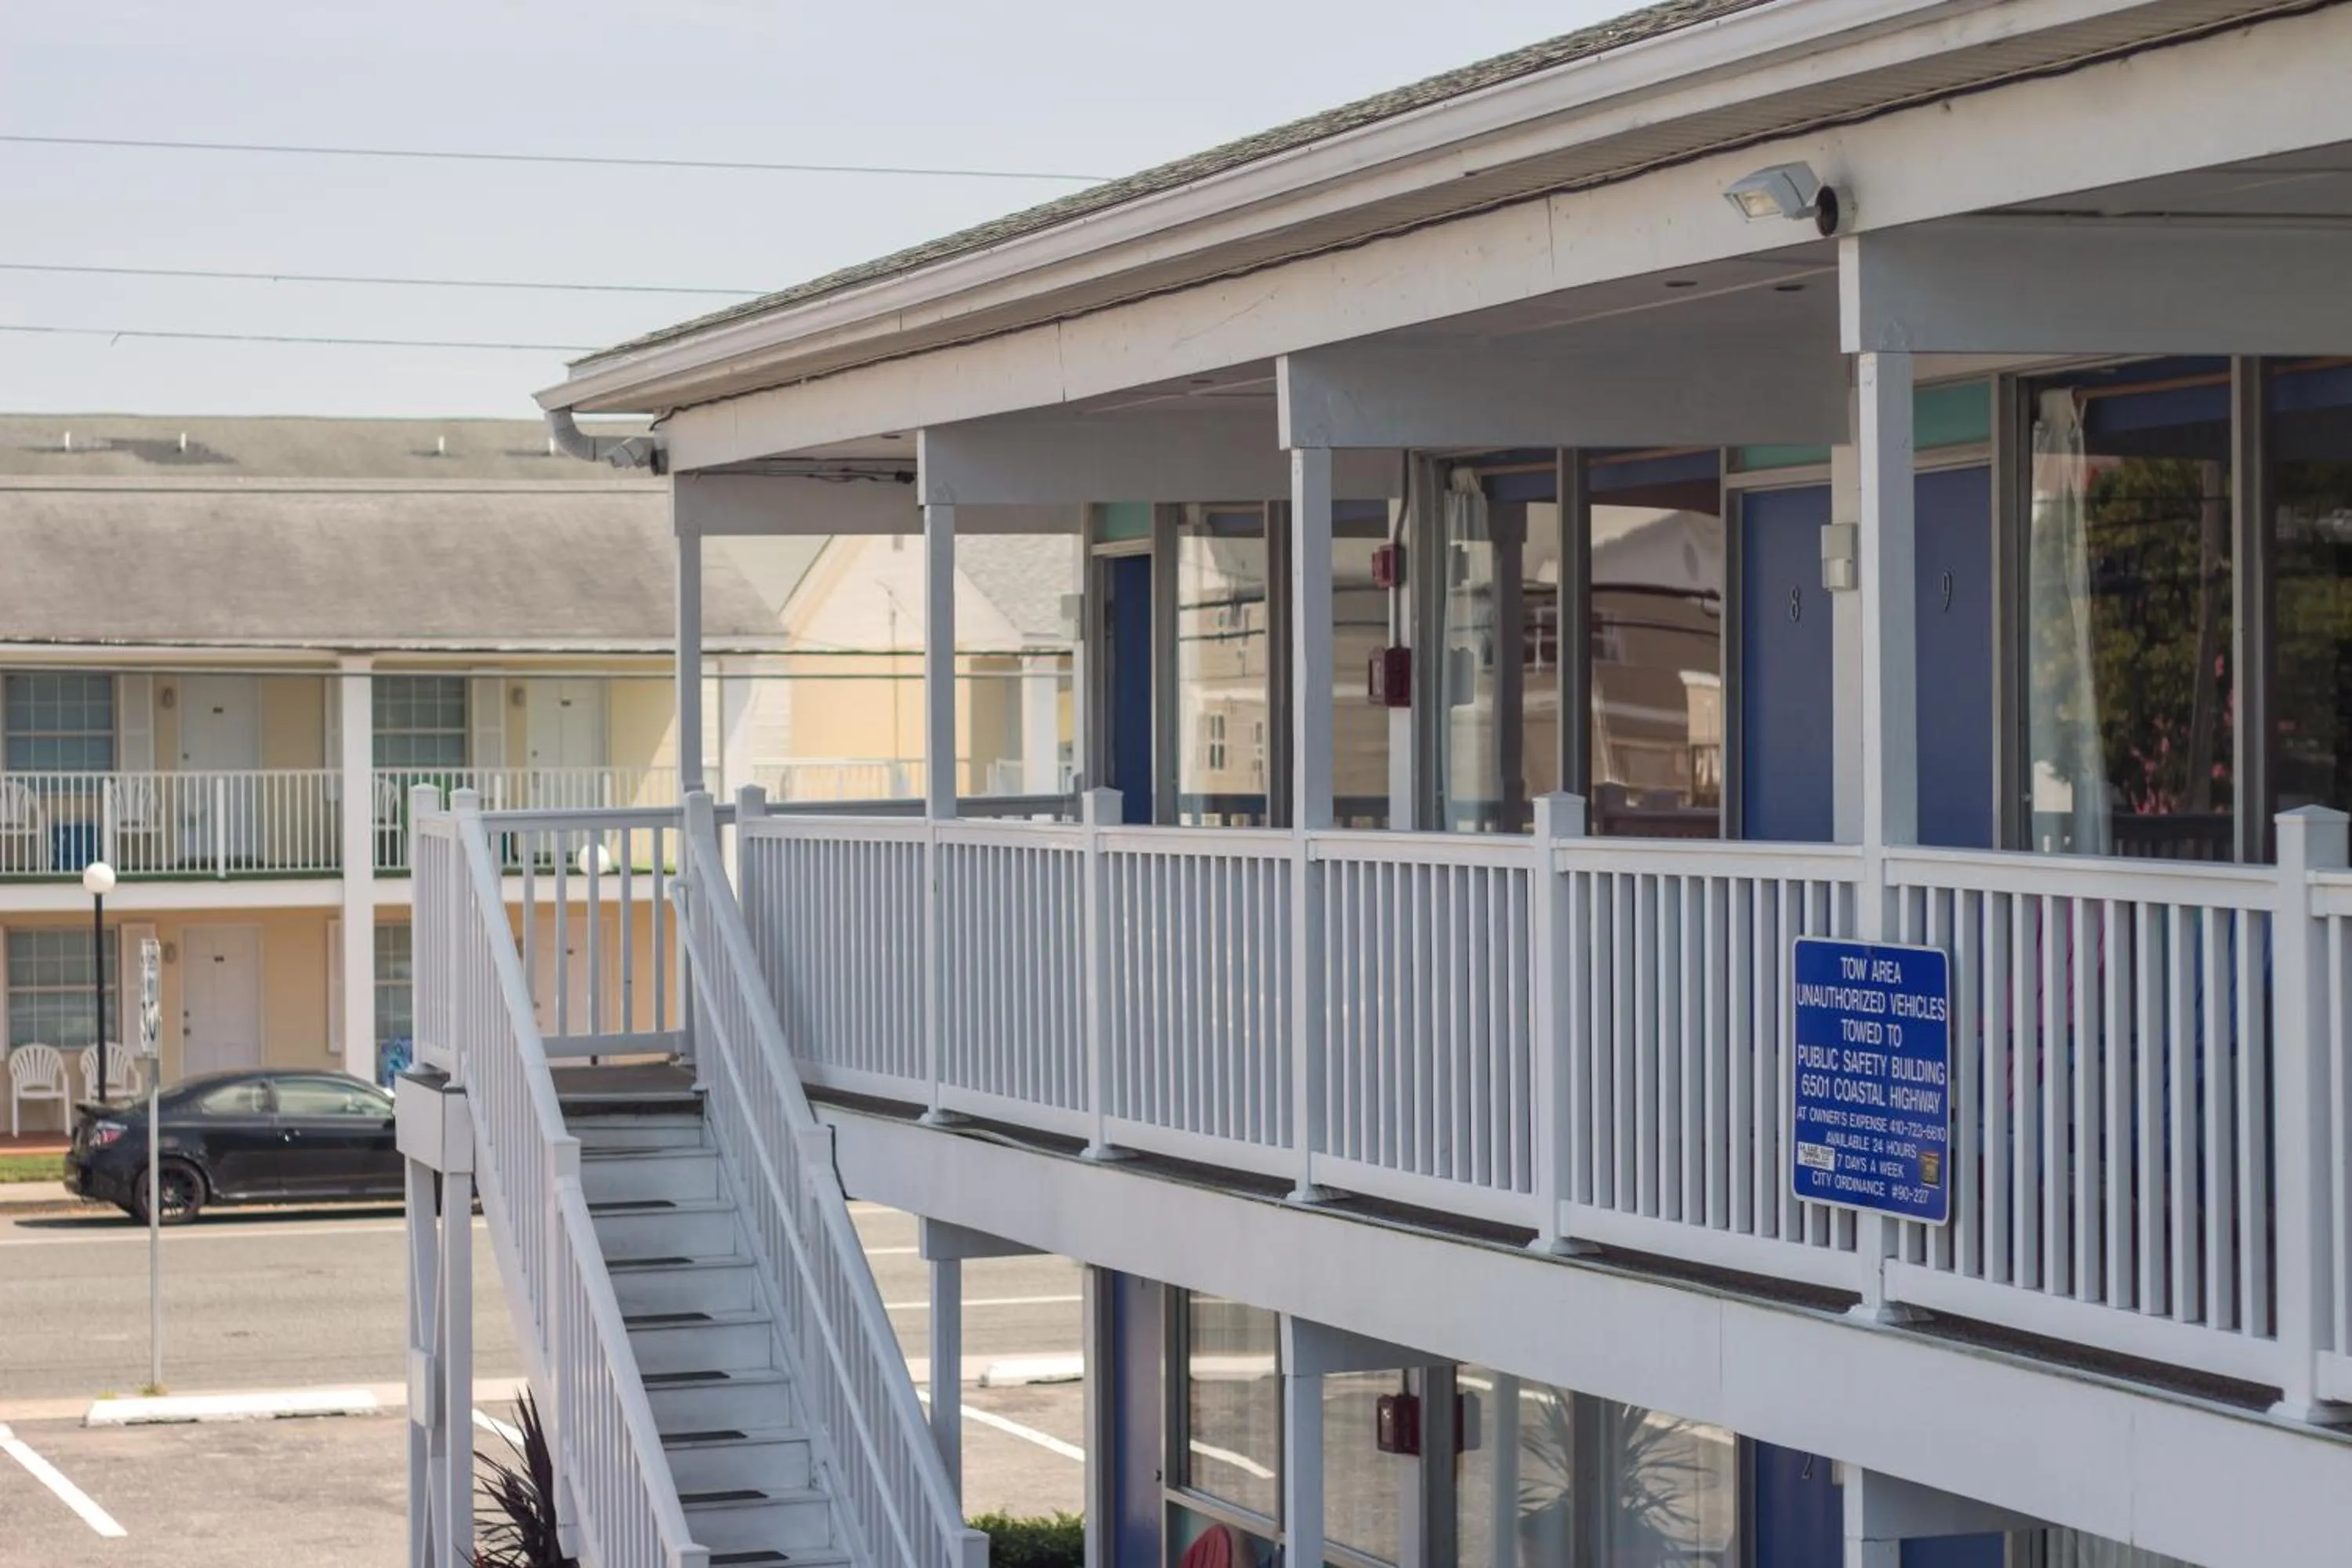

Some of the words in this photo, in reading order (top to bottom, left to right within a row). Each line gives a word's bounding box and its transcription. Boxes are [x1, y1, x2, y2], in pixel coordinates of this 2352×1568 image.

[1840, 956, 1867, 980] TOW
[1871, 960, 1902, 985] AREA
[1797, 984, 1886, 1014] UNAUTHORIZED
[1890, 993, 1946, 1022] VEHICLES
[1841, 1018, 1882, 1045] TOWED
[1886, 1023, 1903, 1047] TO
[1798, 1044, 1838, 1072] PUBLIC
[1843, 1049, 1887, 1076] SAFETY
[1892, 1056, 1946, 1086] BUILDING
[1802, 1073, 1829, 1098] 6501
[1834, 1077, 1886, 1106] COASTAL
[1890, 1086, 1941, 1114] HIGHWAY
[1797, 1106, 1806, 1120] AT
[1849, 1112, 1888, 1133] EXPENSE
[1825, 1131, 1870, 1151] AVAILABLE
[1873, 1138, 1883, 1153] 24
[1886, 1140, 1917, 1160] HOURS
[1837, 1153, 1843, 1168] 7
[1870, 1160, 1877, 1174] A
[1879, 1161, 1904, 1179] WEEK
[1812, 1171, 1832, 1187] CITY
[1834, 1174, 1886, 1198] ORDINANCE
